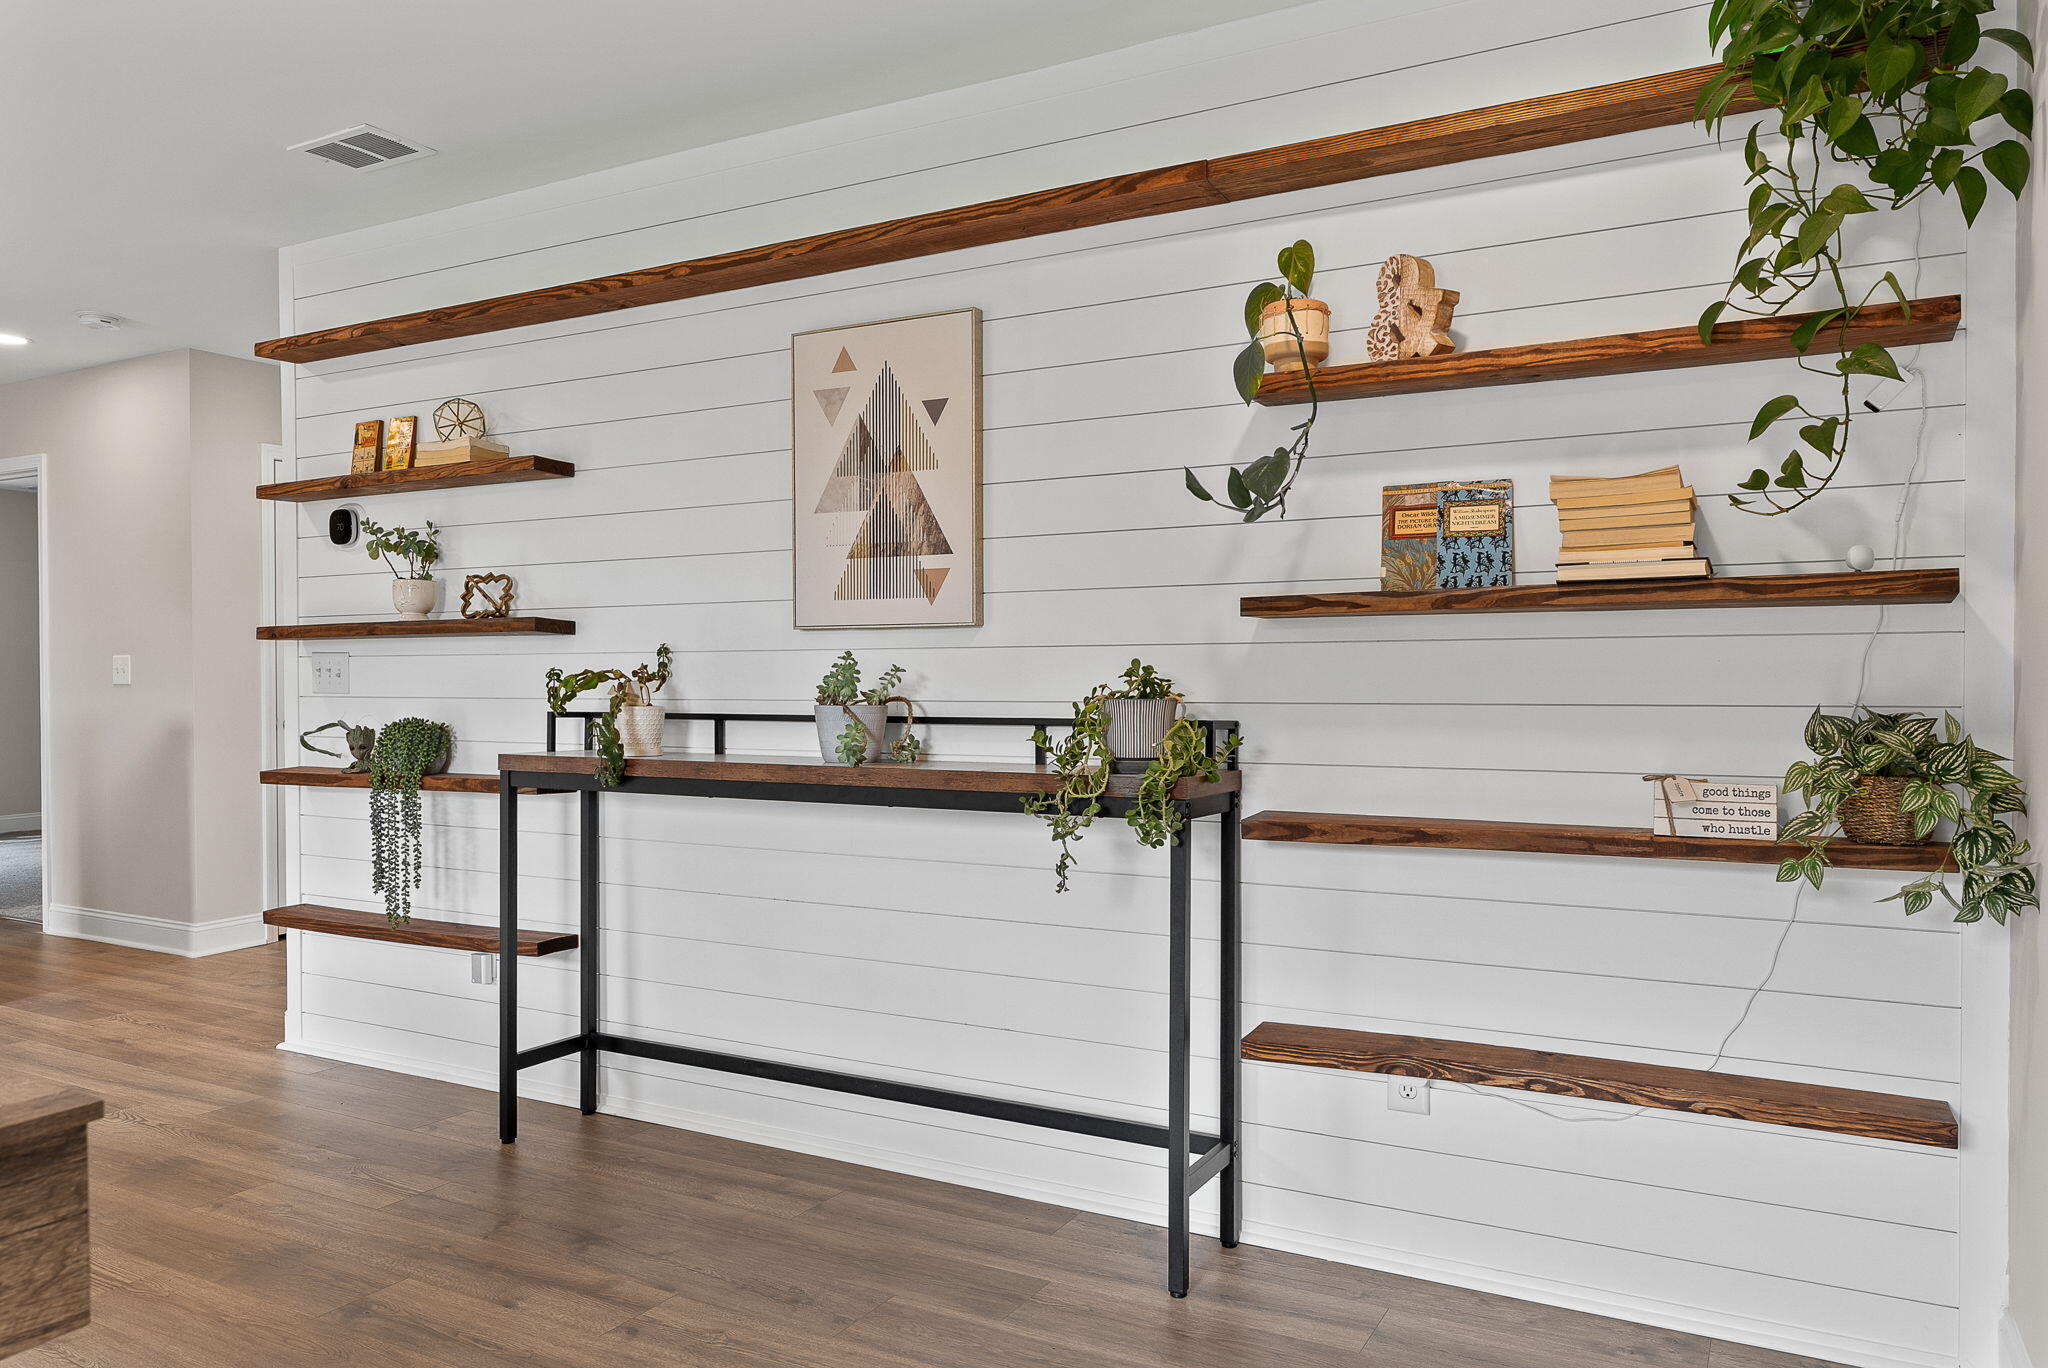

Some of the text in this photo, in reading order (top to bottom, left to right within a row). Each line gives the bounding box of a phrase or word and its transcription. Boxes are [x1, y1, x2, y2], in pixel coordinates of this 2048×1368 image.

[1702, 787, 1771, 800] good things
[1692, 805, 1771, 817] come to those
[1702, 823, 1771, 836] who hustle
